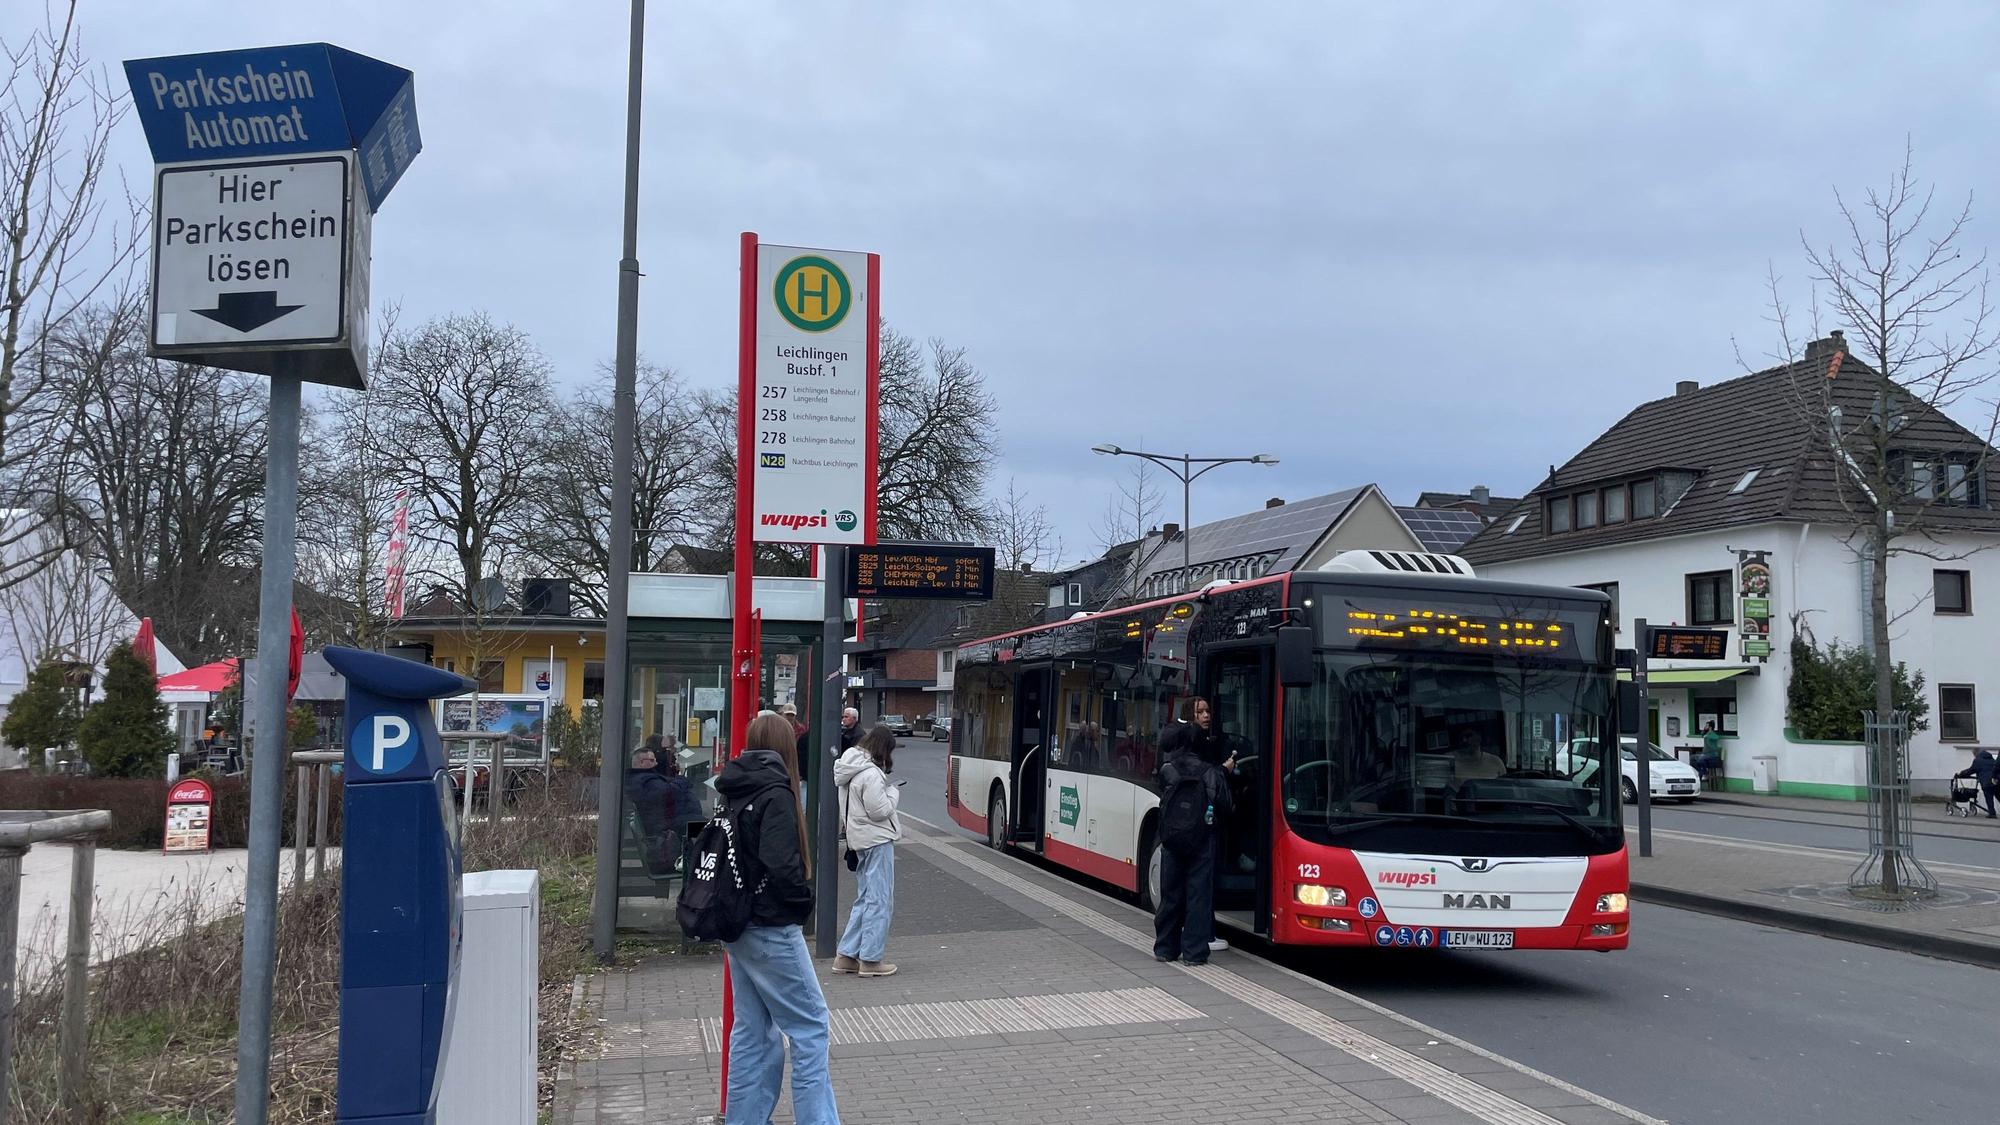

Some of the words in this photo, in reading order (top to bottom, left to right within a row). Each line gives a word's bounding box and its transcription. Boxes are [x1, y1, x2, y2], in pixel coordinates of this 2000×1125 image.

[149, 61, 314, 110] Parkschein
[184, 105, 308, 149] Automat
[219, 175, 282, 204] Hier
[166, 210, 336, 245] Parkschein
[207, 254, 290, 282] lösen
[798, 272, 828, 315] H
[777, 345, 848, 363] Leichlingen
[787, 363, 825, 376] Busbf.
[831, 366, 836, 377] 1
[762, 386, 787, 399] 257
[793, 386, 828, 396] Leichlingen
[830, 388, 856, 396] Bahnhof
[793, 395, 828, 404] Langenfeld
[762, 409, 787, 422] 258
[793, 413, 828, 423] Leichlingen
[829, 415, 856, 423] Bahnhof
[761, 432, 787, 444] 278
[792, 436, 828, 445] Leichlingen
[829, 437, 856, 445] Bahnhof
[761, 454, 785, 467] N28
[823, 459, 858, 469] Leichlingen
[761, 509, 827, 530] wupsi
[835, 514, 852, 522] VRS
[925, 556, 938, 564] Hbf
[884, 571, 923, 579] CHEMPARK
[1250, 607, 1267, 618] MAN
[1237, 622, 1246, 635] 123
[372, 715, 410, 770] P
[1298, 864, 1320, 878] 123
[1378, 867, 1436, 888] wupsi
[1443, 893, 1511, 909] MAN
[1448, 933, 1468, 945] LEV
[1476, 933, 1489, 945] WU
[1492, 934, 1512, 946] 123
